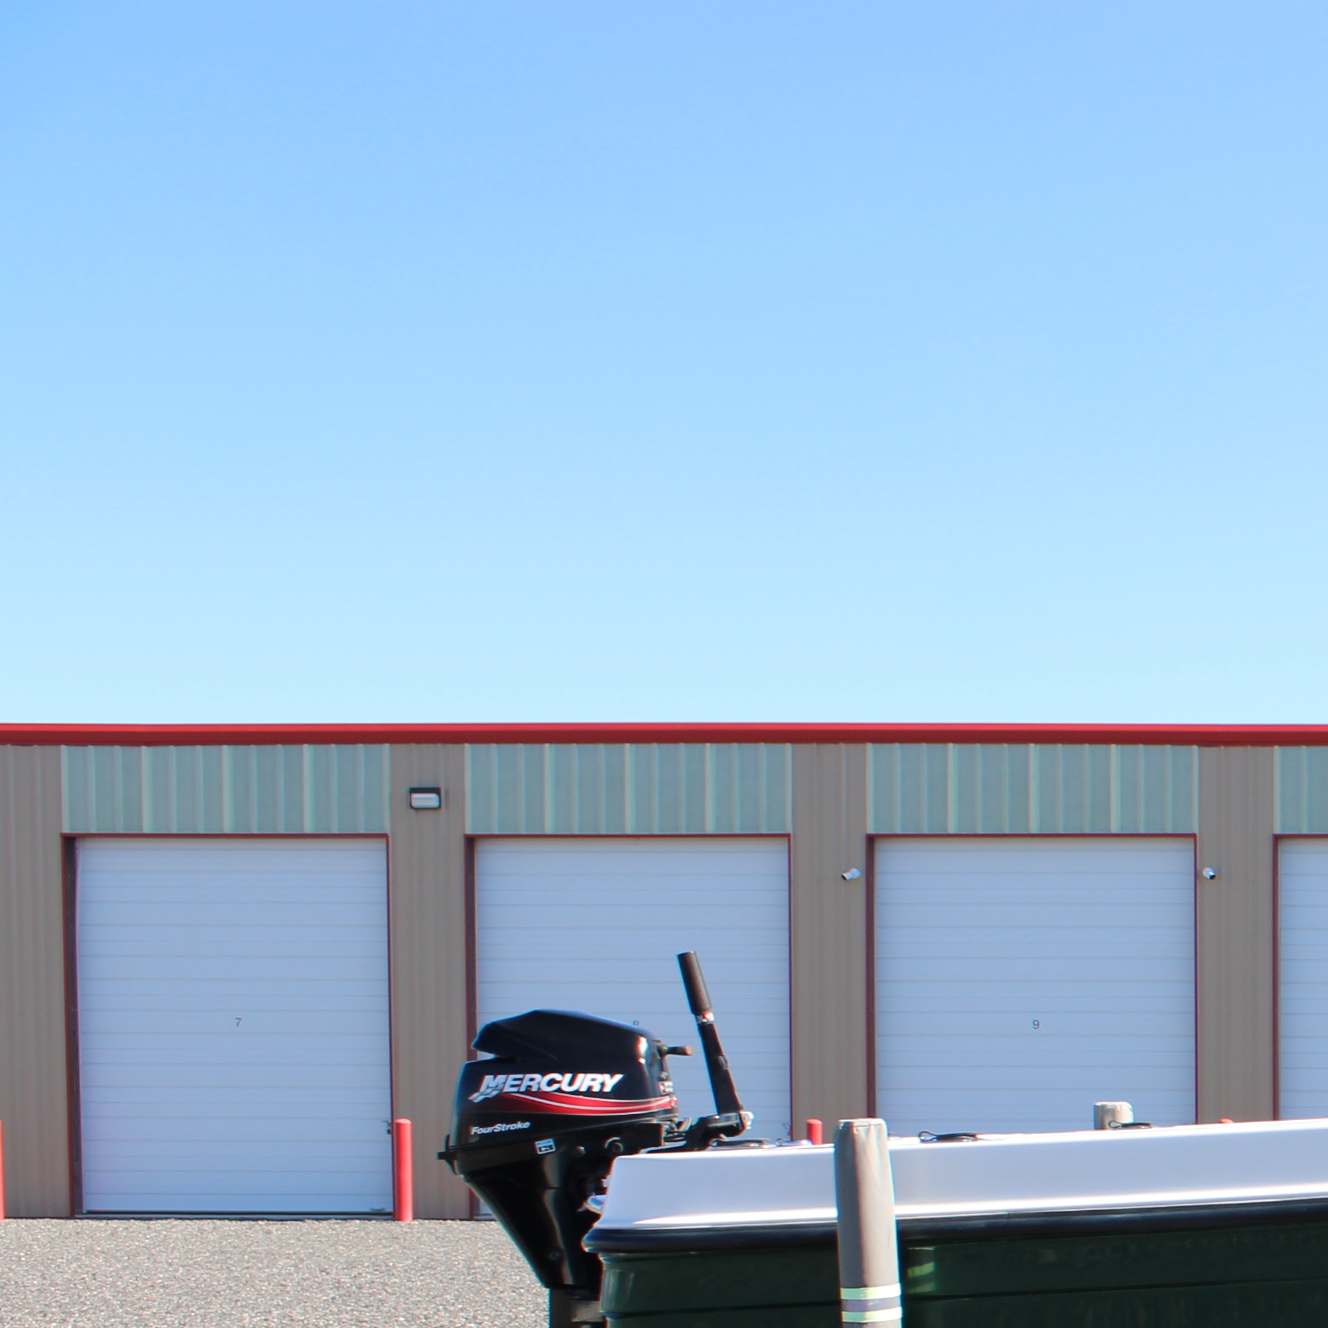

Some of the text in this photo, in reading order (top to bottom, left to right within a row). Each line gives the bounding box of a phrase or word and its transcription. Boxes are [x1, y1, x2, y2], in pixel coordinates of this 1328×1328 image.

[234, 1016, 243, 1028] 7
[1032, 1019, 1040, 1030] 9
[470, 1072, 624, 1101] MERCURY
[470, 1120, 531, 1135] FourStroke
